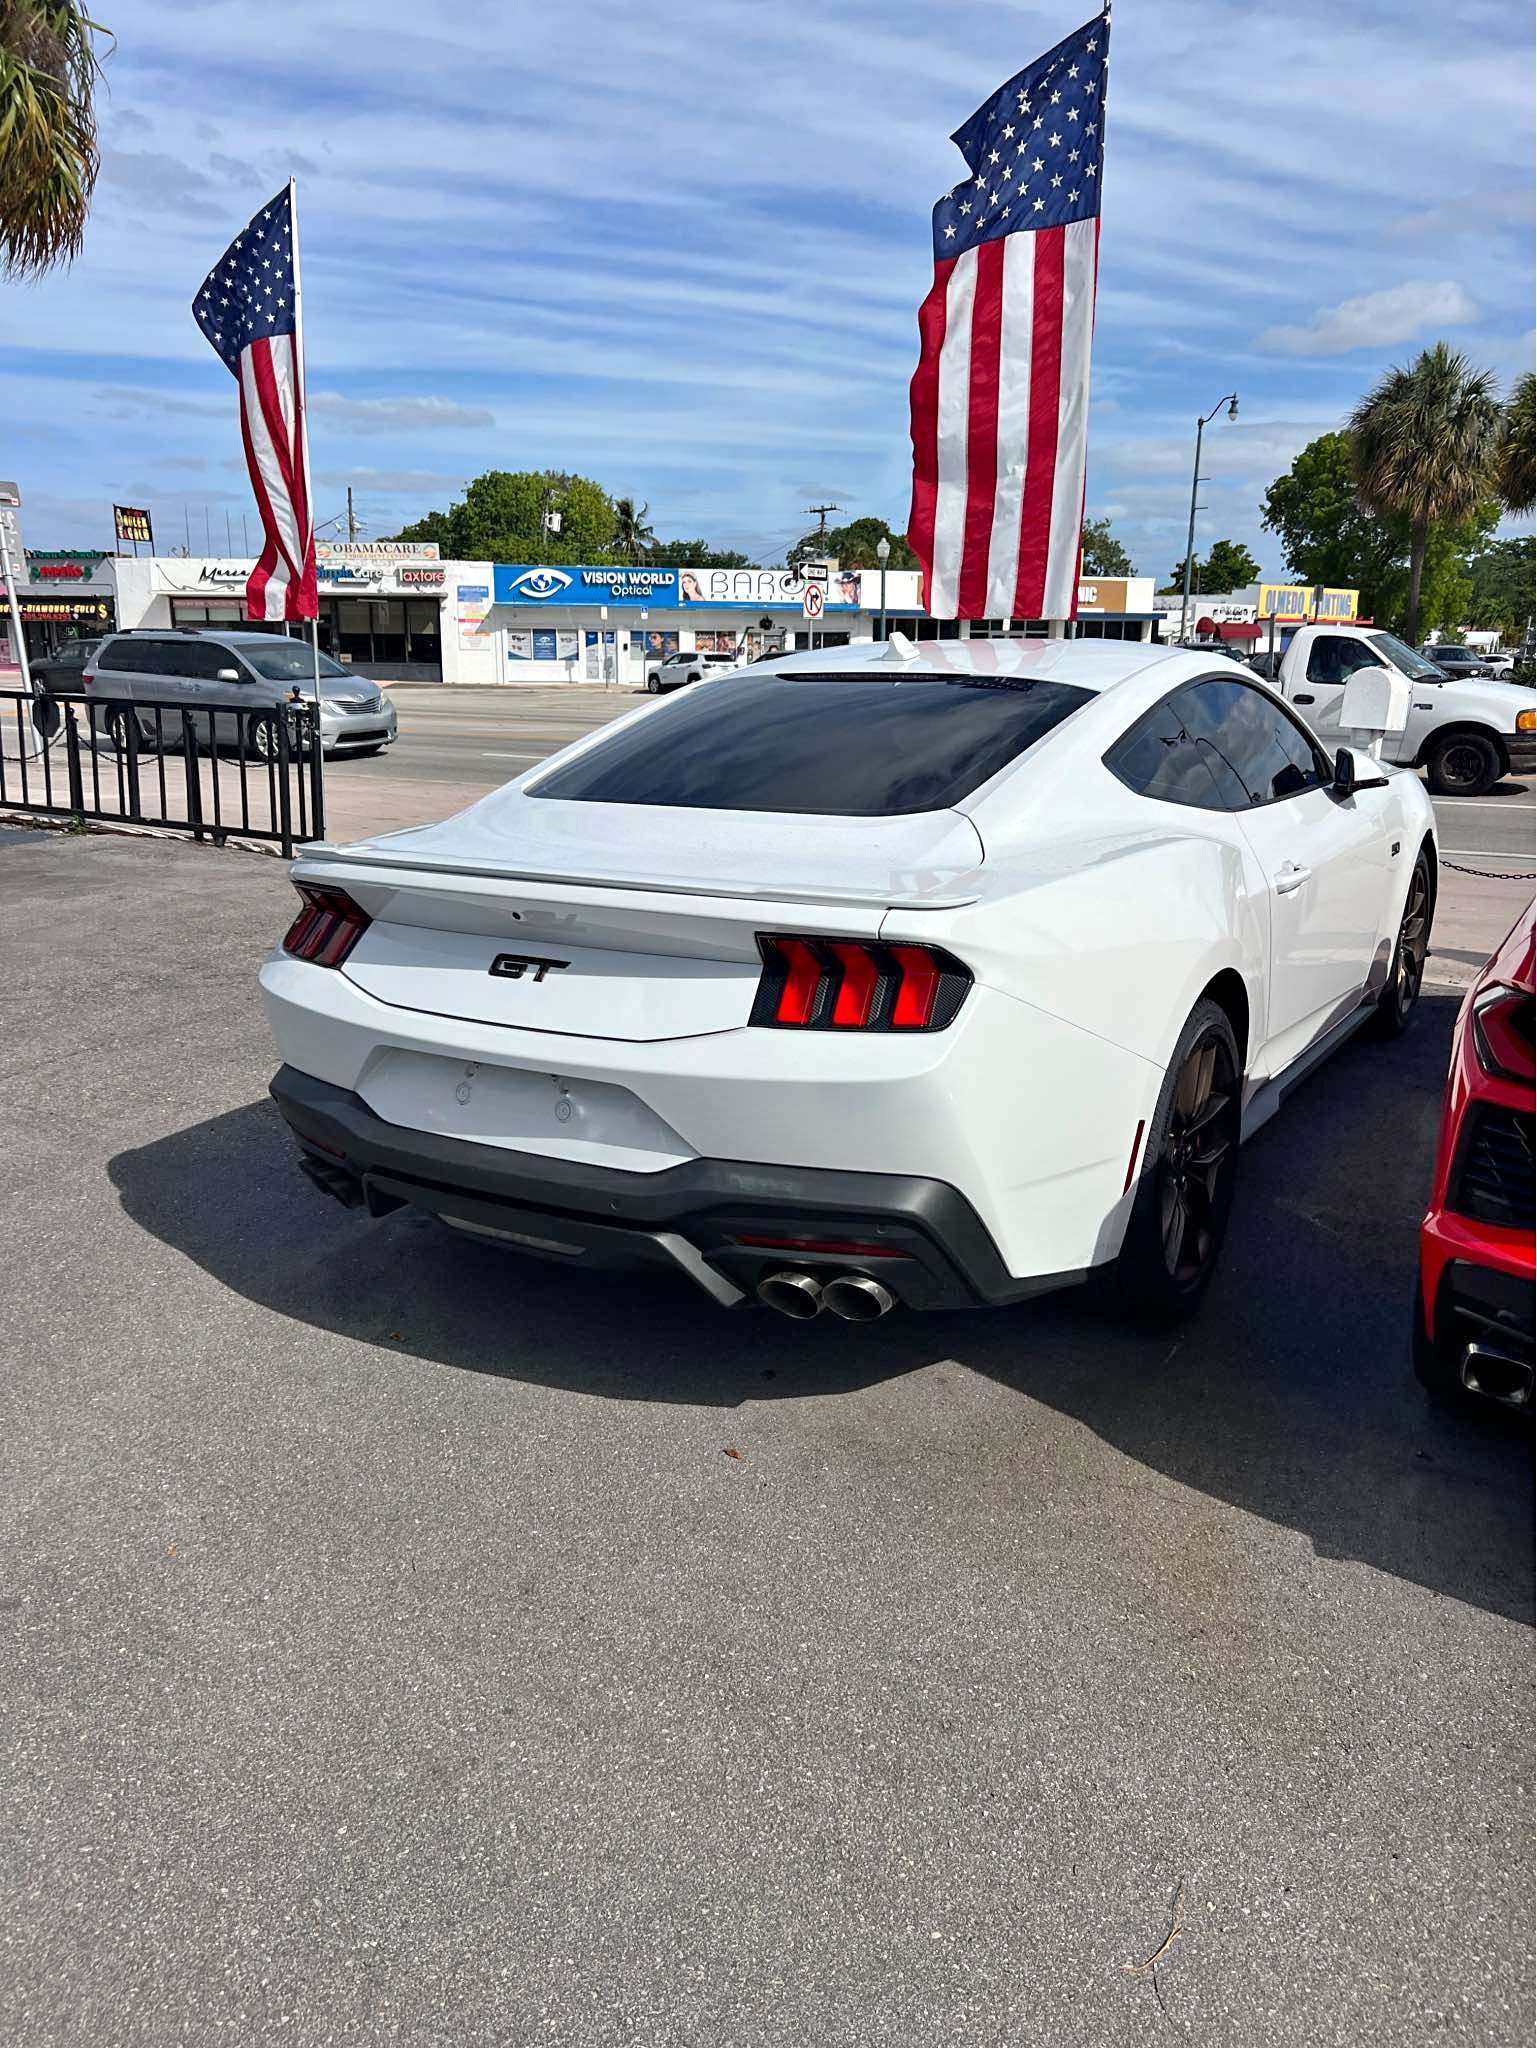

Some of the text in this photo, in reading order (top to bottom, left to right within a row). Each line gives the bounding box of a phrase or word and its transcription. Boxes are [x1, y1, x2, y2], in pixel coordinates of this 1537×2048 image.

[333, 543, 421, 554] OBAMACARE
[583, 571, 675, 585] VISION WORLD
[711, 571, 829, 595] BARO
[611, 585, 653, 597] Optical
[1265, 589, 1305, 614] OLMEDO
[488, 953, 572, 982] GT
